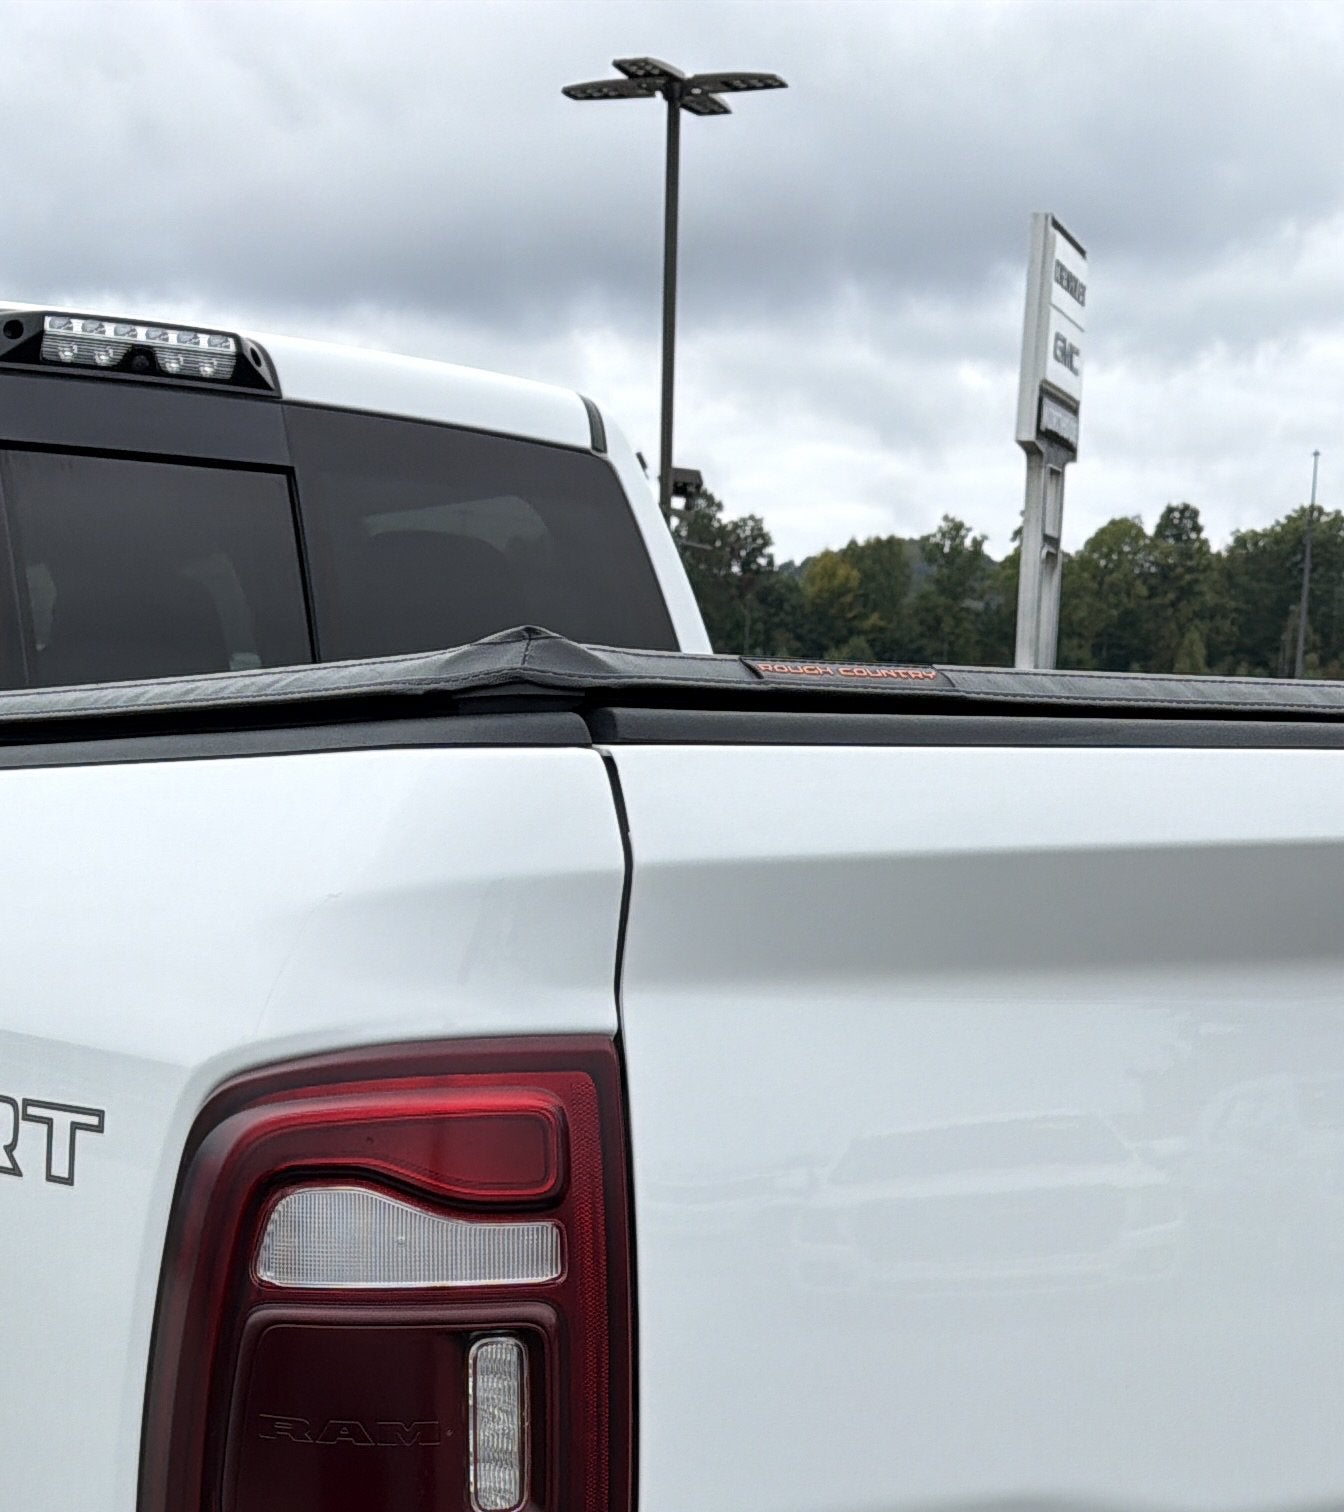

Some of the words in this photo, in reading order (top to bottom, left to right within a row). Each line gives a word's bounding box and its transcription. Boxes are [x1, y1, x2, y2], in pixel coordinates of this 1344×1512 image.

[757, 663, 833, 675] ROUGH
[838, 667, 937, 680] COUNTRY
[259, 1414, 441, 1446] RAM
